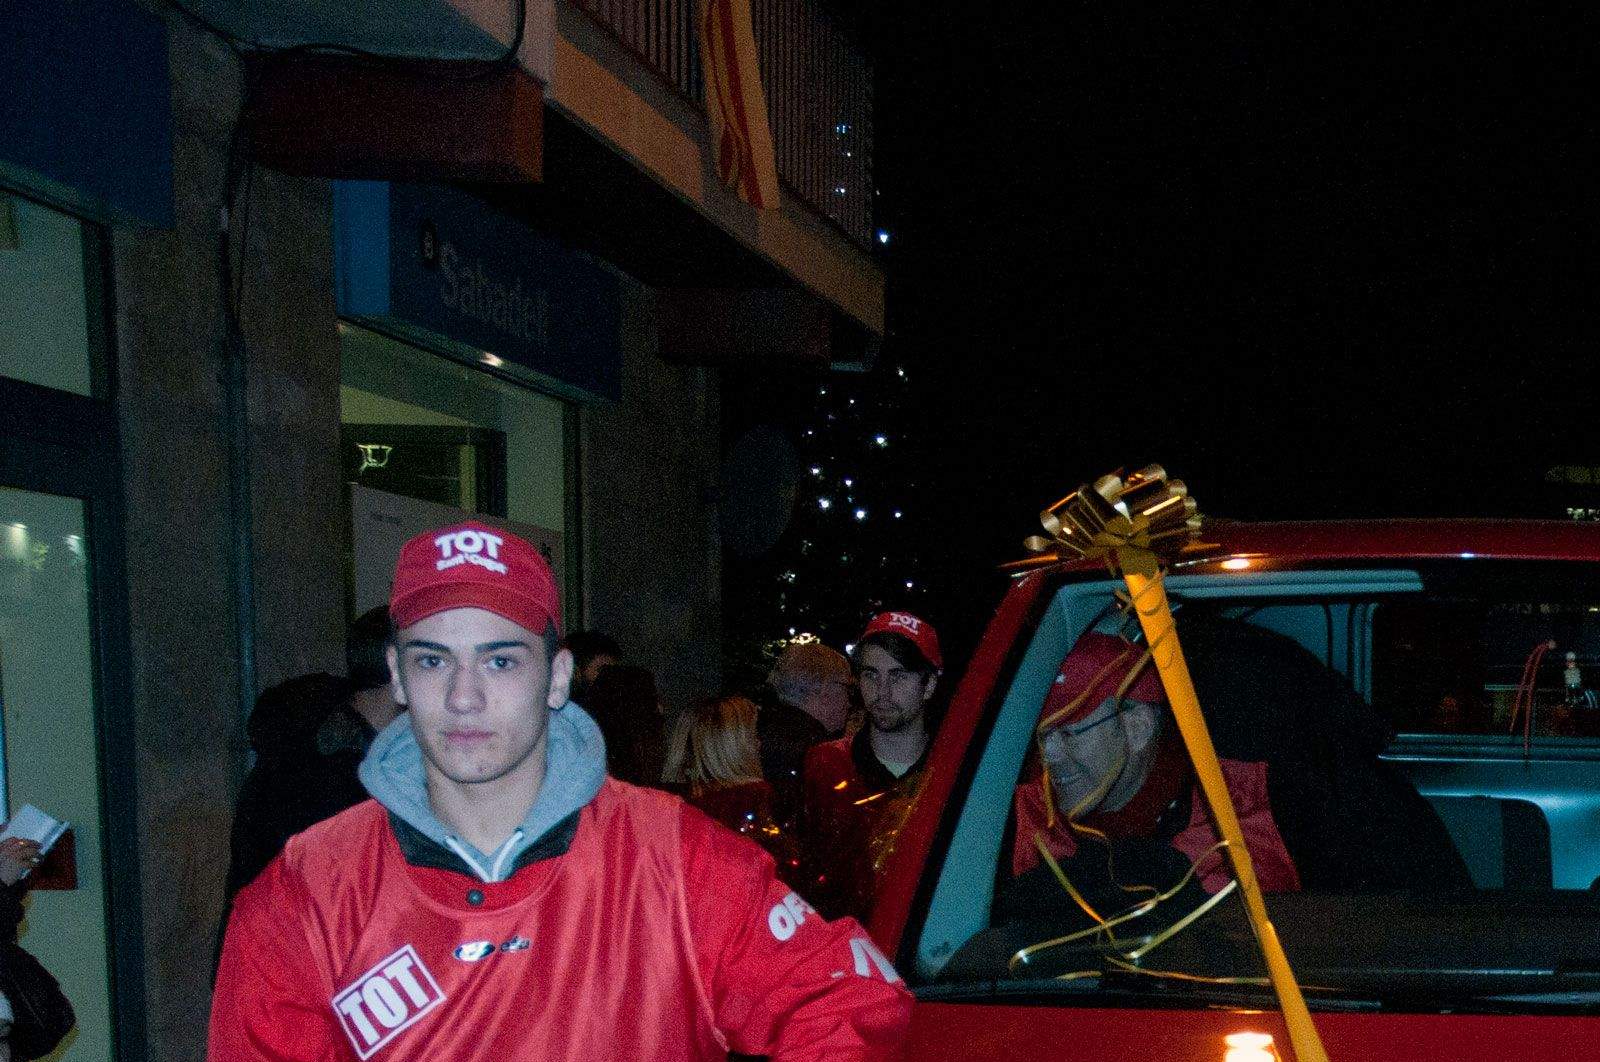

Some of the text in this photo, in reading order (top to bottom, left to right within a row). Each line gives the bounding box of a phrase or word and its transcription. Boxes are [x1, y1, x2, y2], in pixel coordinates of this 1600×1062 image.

[434, 530, 504, 559] TOT
[888, 612, 922, 630] TOT
[336, 951, 432, 1047] TOT
